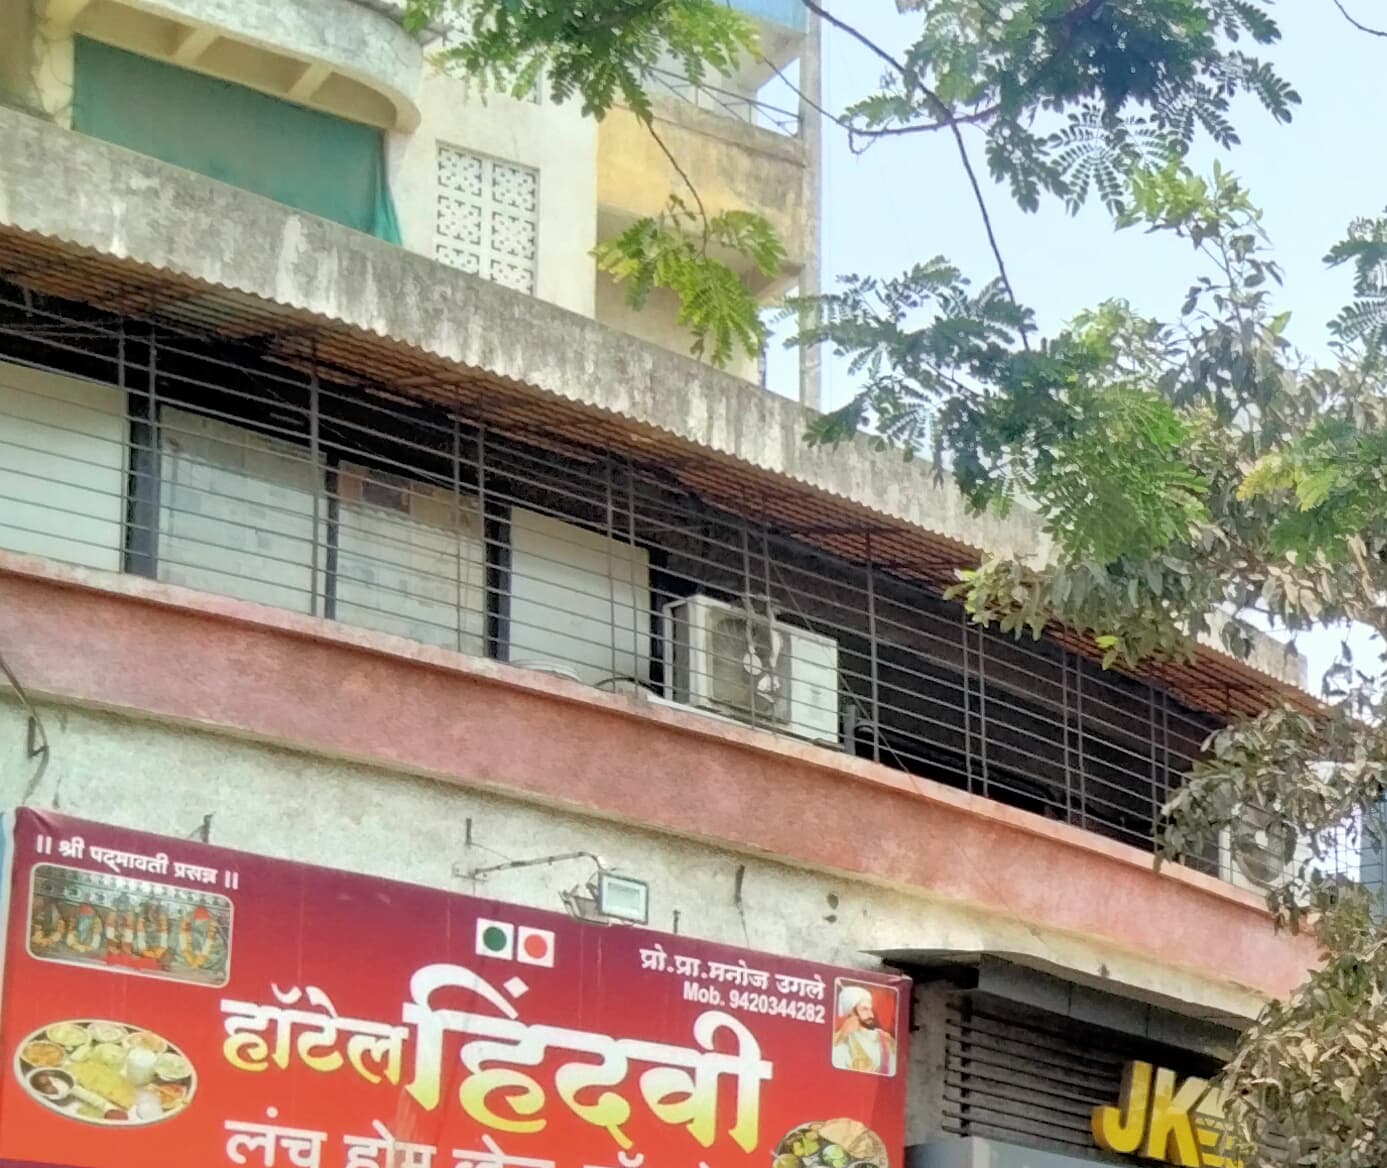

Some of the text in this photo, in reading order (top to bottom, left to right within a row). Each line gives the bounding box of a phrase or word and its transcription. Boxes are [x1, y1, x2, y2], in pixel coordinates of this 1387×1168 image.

[58, 836, 84, 860] श्री
[173, 861, 217, 884] प्रसन्न
[683, 981, 826, 1024] Mob. 9420344282
[774, 974, 826, 1000] उगले
[221, 963, 772, 1154] हॉटेल हिंदवी
